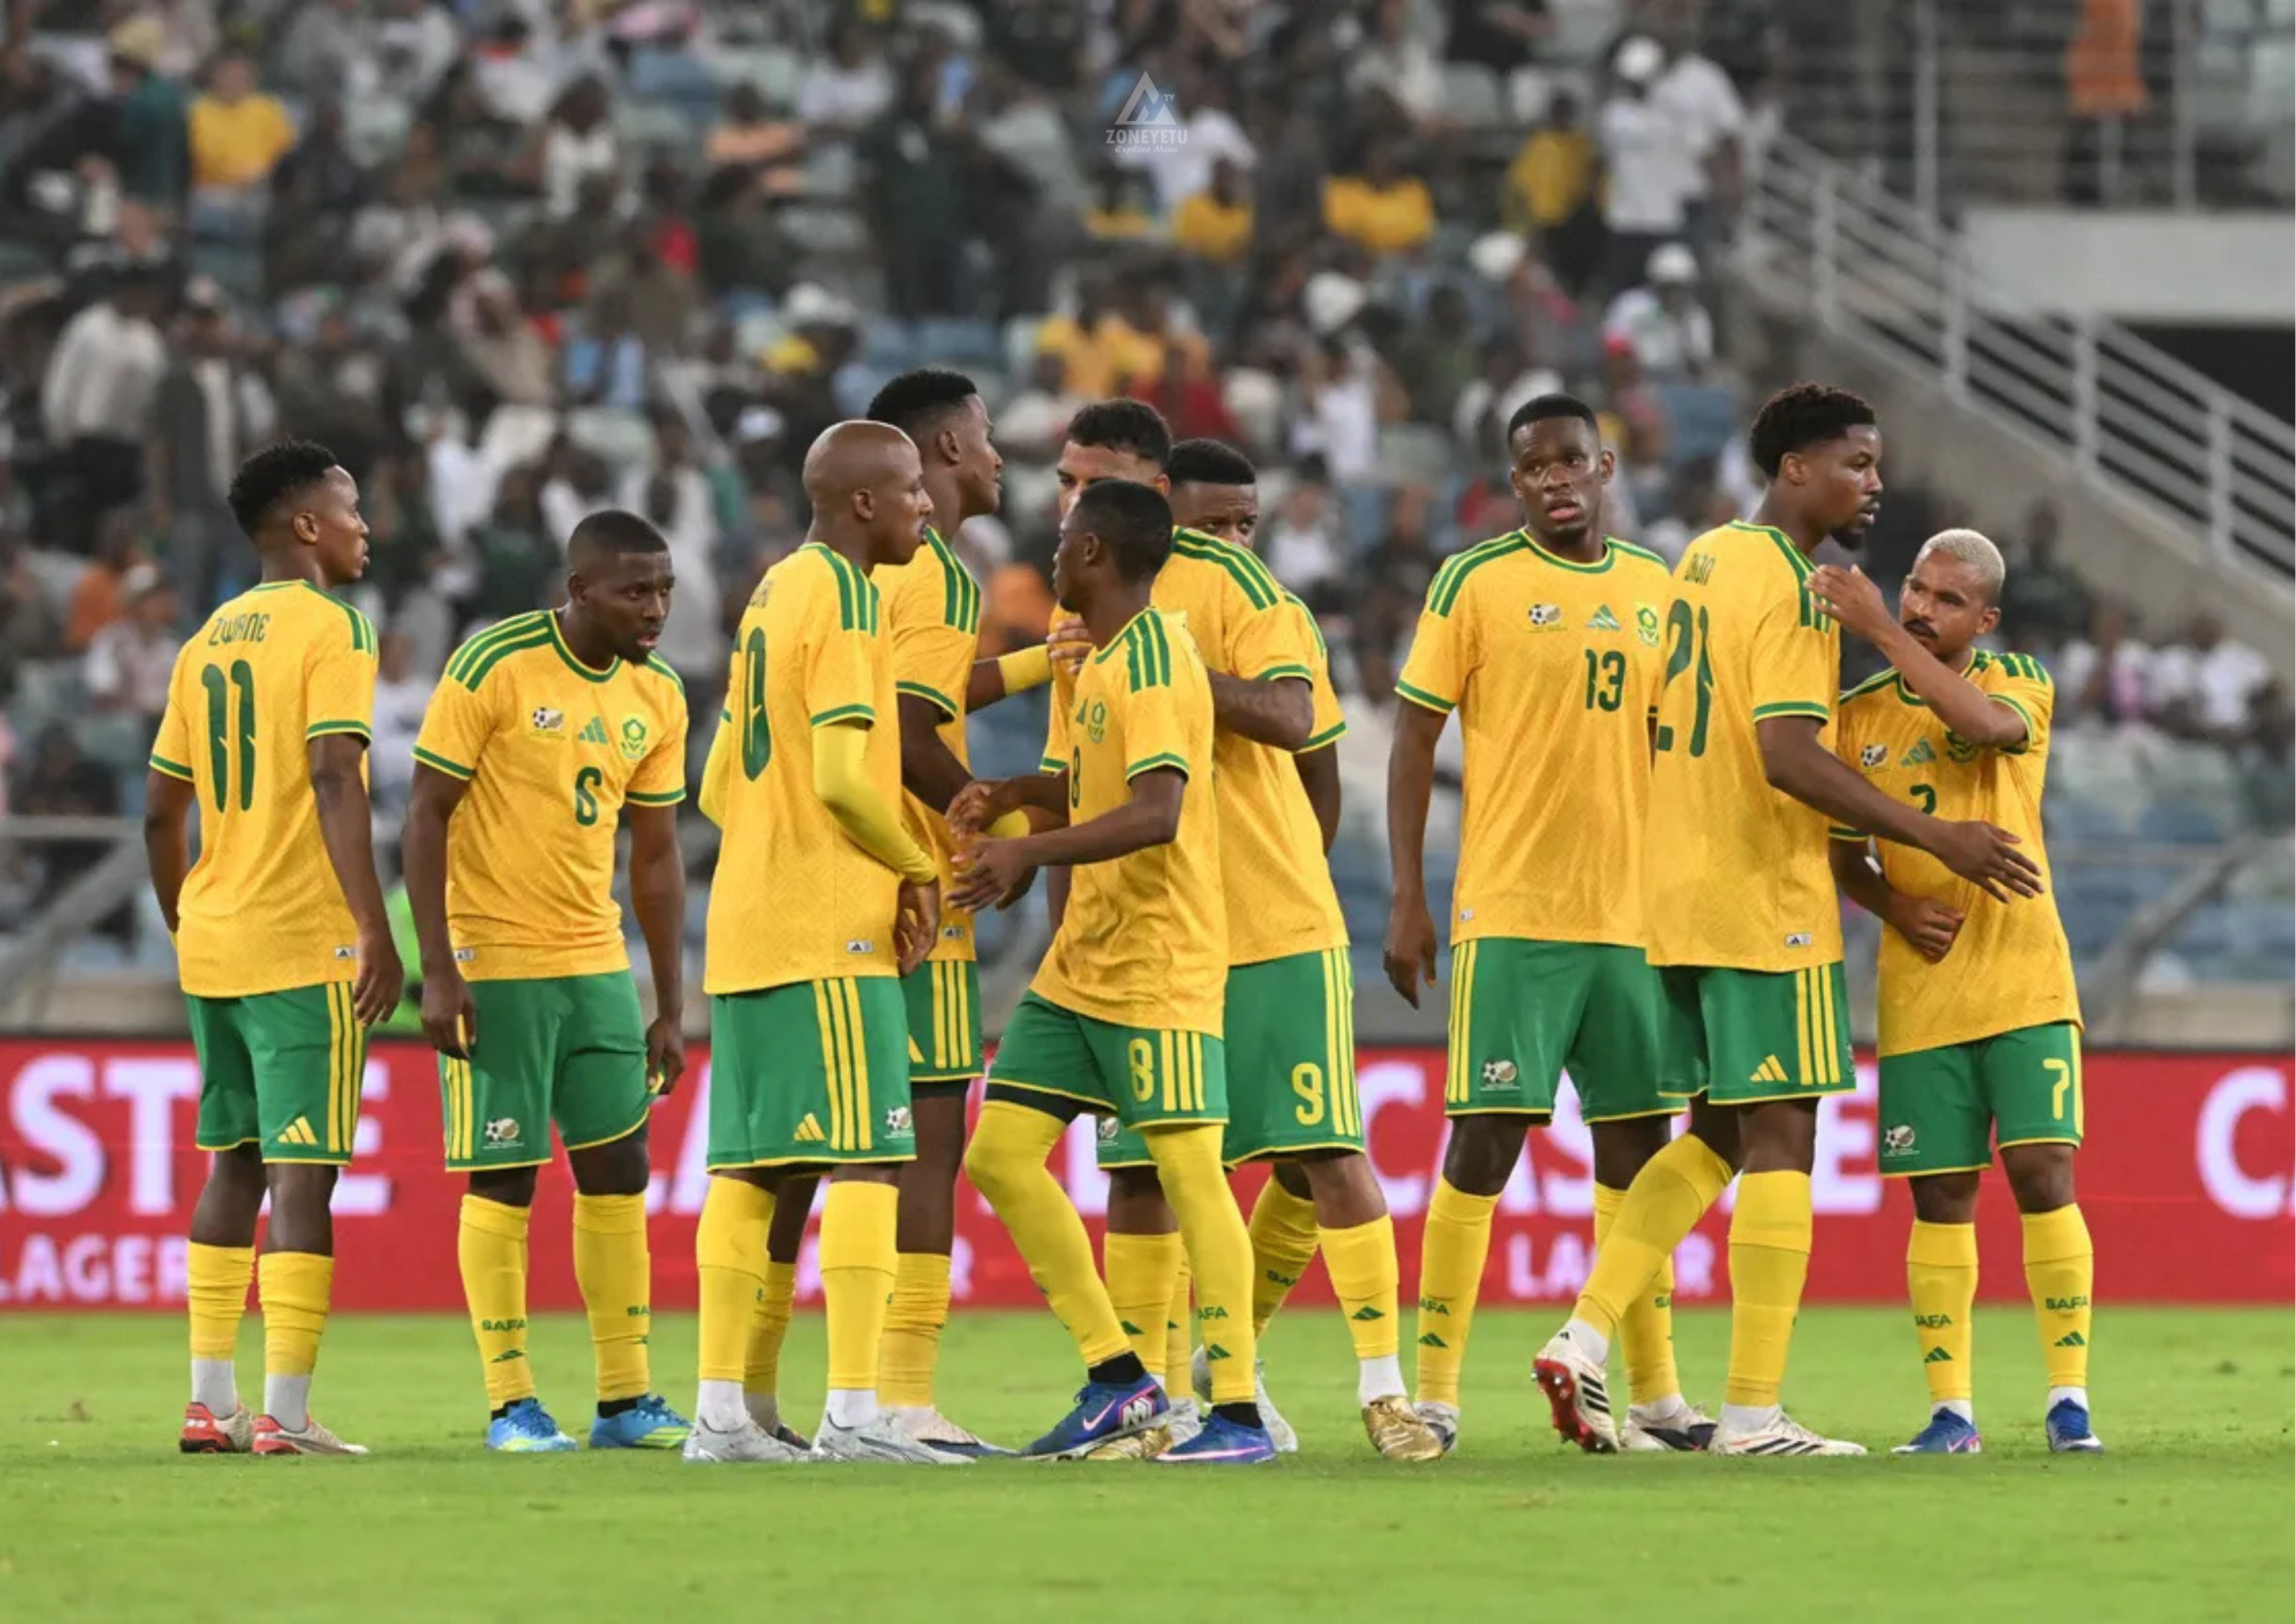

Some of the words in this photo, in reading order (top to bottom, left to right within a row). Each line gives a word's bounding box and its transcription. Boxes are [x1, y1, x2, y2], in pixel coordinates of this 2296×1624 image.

[208, 613, 270, 646] ZWANE
[729, 626, 771, 782] 0
[1585, 649, 1626, 712] 13
[1657, 599, 1714, 758] 21
[201, 659, 255, 813] 11
[576, 766, 602, 827] 6
[1071, 746, 1081, 809] 8
[1128, 1038, 1154, 1102] 8
[1292, 1062, 1324, 1126] 9
[2043, 1059, 2070, 1120] 7
[2195, 1066, 2295, 1219] C
[0, 1234, 188, 1303] AGER
[1507, 1233, 1715, 1299] LAR
[1196, 1307, 1228, 1320] AFA
[2046, 1296, 2088, 1310] SAFA
